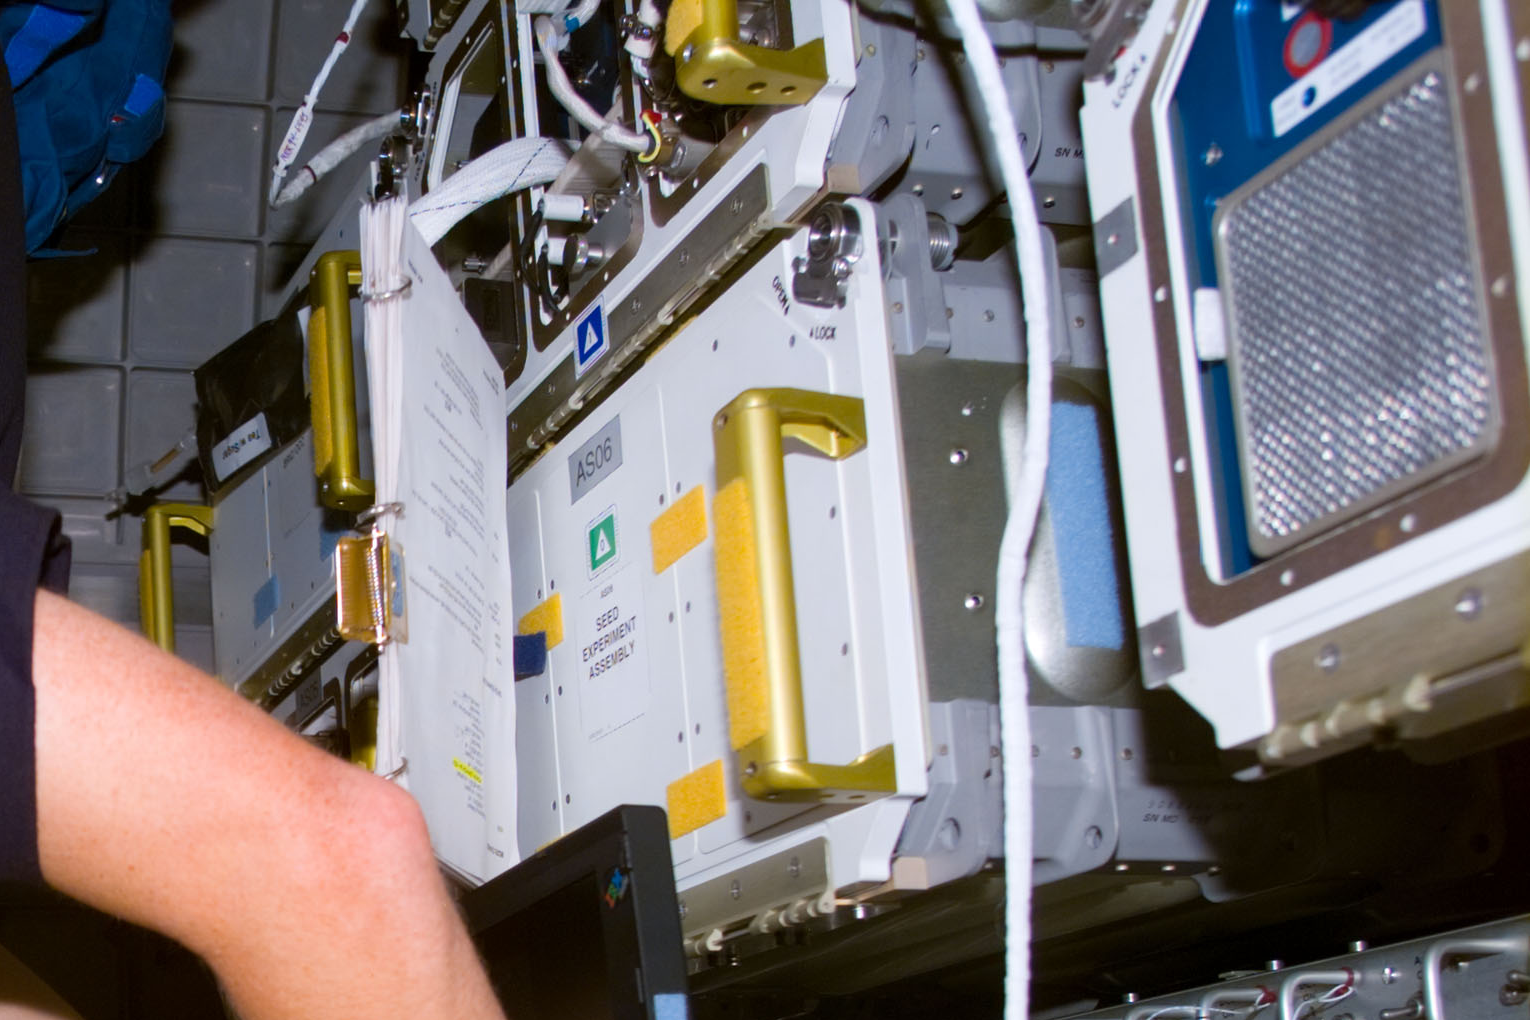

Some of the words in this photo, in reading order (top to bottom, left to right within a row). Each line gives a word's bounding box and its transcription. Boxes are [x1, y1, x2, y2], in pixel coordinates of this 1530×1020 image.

[1112, 64, 1139, 108] LOCK
[1055, 147, 1070, 157] SN
[772, 275, 788, 308] OPEN
[815, 326, 836, 340] LOCK
[248, 429, 261, 442] Tea
[576, 437, 612, 487] AS06
[596, 606, 619, 632] SEED
[582, 615, 636, 662] EXPERIMENT
[589, 640, 635, 680] ASSEMBLY
